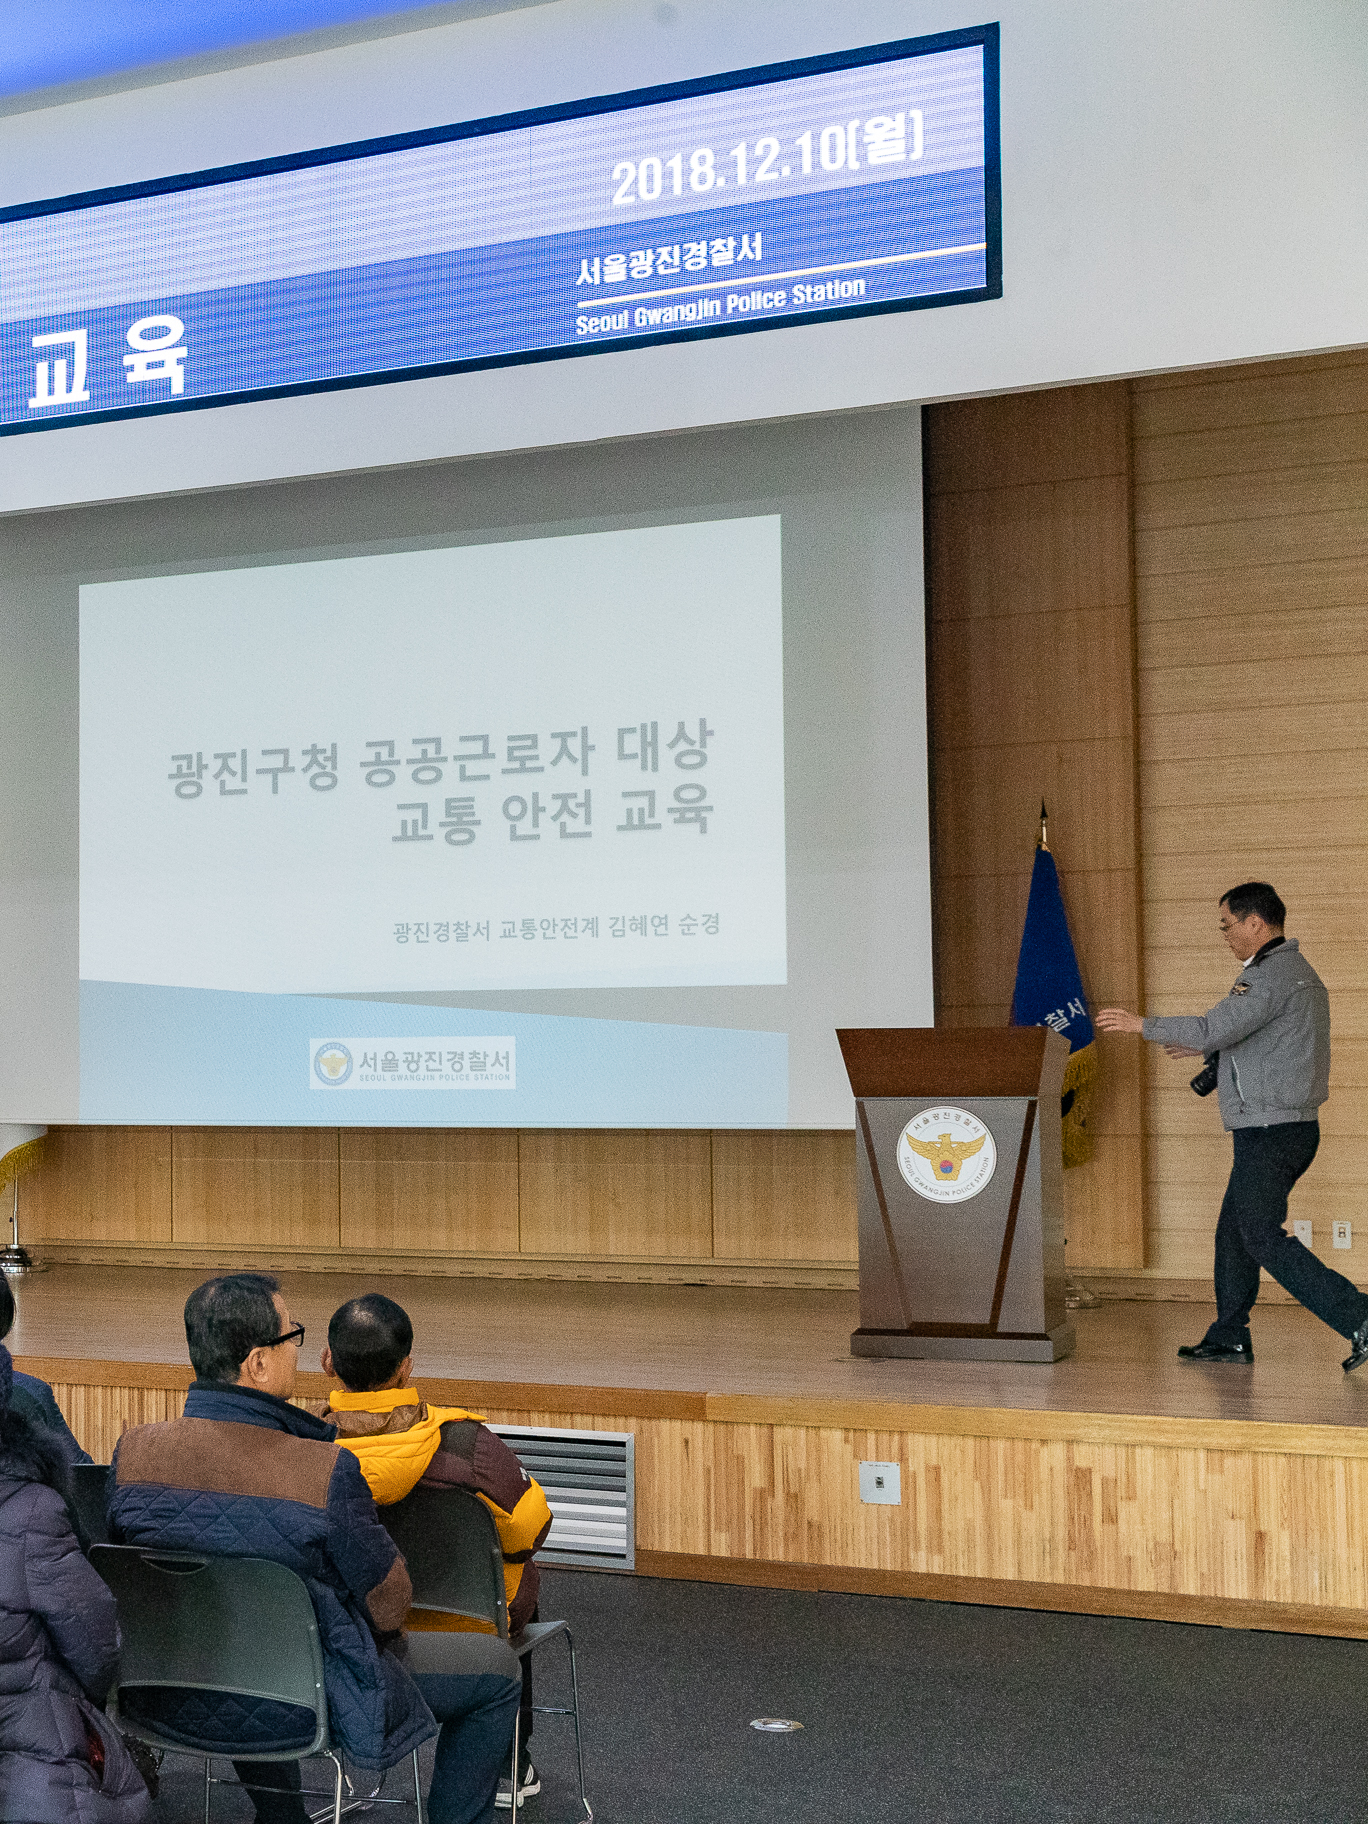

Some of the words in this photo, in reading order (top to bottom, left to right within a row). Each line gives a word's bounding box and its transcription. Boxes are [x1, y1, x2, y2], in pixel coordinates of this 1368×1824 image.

[576, 232, 762, 285] 서울광진경찰서
[576, 309, 629, 335] Seoul
[634, 298, 721, 327] Gwangjin
[727, 290, 787, 313] Police
[793, 279, 866, 304] Station
[167, 742, 339, 800] 광진구청
[359, 725, 596, 788] 공공근로자
[616, 717, 715, 773] 대상
[391, 796, 482, 847] 교통
[501, 788, 593, 842] 안전
[615, 783, 715, 835] 교육
[393, 920, 491, 945] 광진경찰서
[499, 916, 599, 941] 교통안전계
[608, 913, 669, 939] 김혜연
[678, 912, 720, 936] 순경
[359, 1050, 510, 1073] 서울광진경찰서
[359, 1073, 386, 1082] SEOUL
[390, 1073, 435, 1082] GWANGJIN
[439, 1073, 470, 1081] POLICE
[474, 1073, 510, 1081] STATION
[904, 1156, 916, 1176] SEOUL
[914, 1176, 950, 1196] GWANGJIN
[951, 1182, 975, 1196] POLICE
[974, 1156, 990, 1184] STATION
